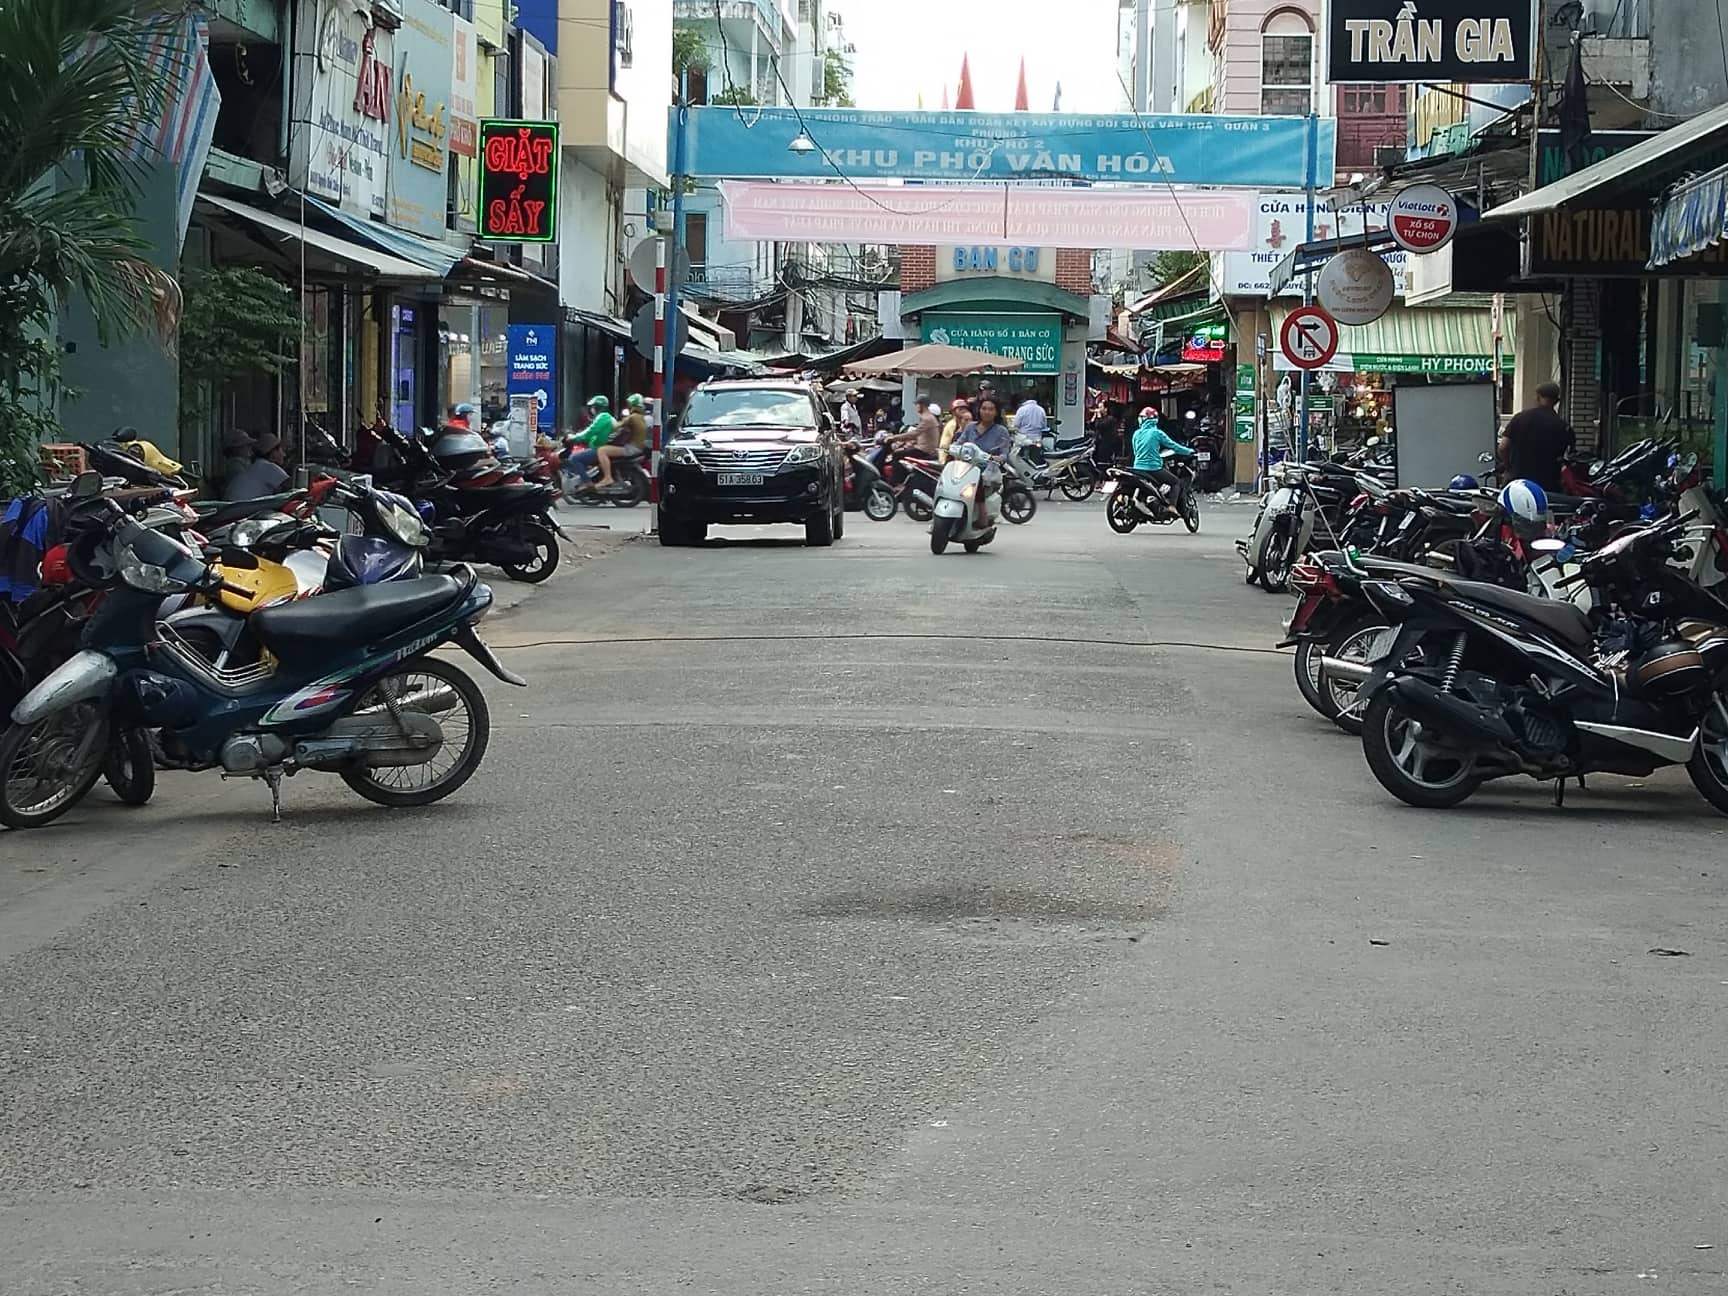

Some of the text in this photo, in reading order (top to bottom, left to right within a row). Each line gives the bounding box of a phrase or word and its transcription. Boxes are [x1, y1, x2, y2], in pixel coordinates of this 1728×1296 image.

[1345, 1, 1515, 63] TRẦN GIA
[1261, 123, 1270, 131] 3
[955, 139, 987, 148] KHU
[1034, 140, 1045, 148] 2
[485, 128, 553, 180] GIẶT
[819, 149, 897, 167] KHU
[1006, 150, 1082, 171] VĂN
[1097, 151, 1176, 174] HÓA
[489, 184, 545, 234] SẤY
[1260, 200, 1290, 213] CỬA
[1398, 200, 1436, 213] Vietlott
[1423, 219, 1435, 230] SỐ
[1403, 228, 1440, 240] TỰ CHỌN
[1543, 209, 1648, 262] NATURAL
[970, 329, 995, 338] HÀNG
[1002, 345, 1034, 362] TRANG
[1035, 343, 1055, 361] SỨC
[1444, 358, 1494, 372] PHONG
